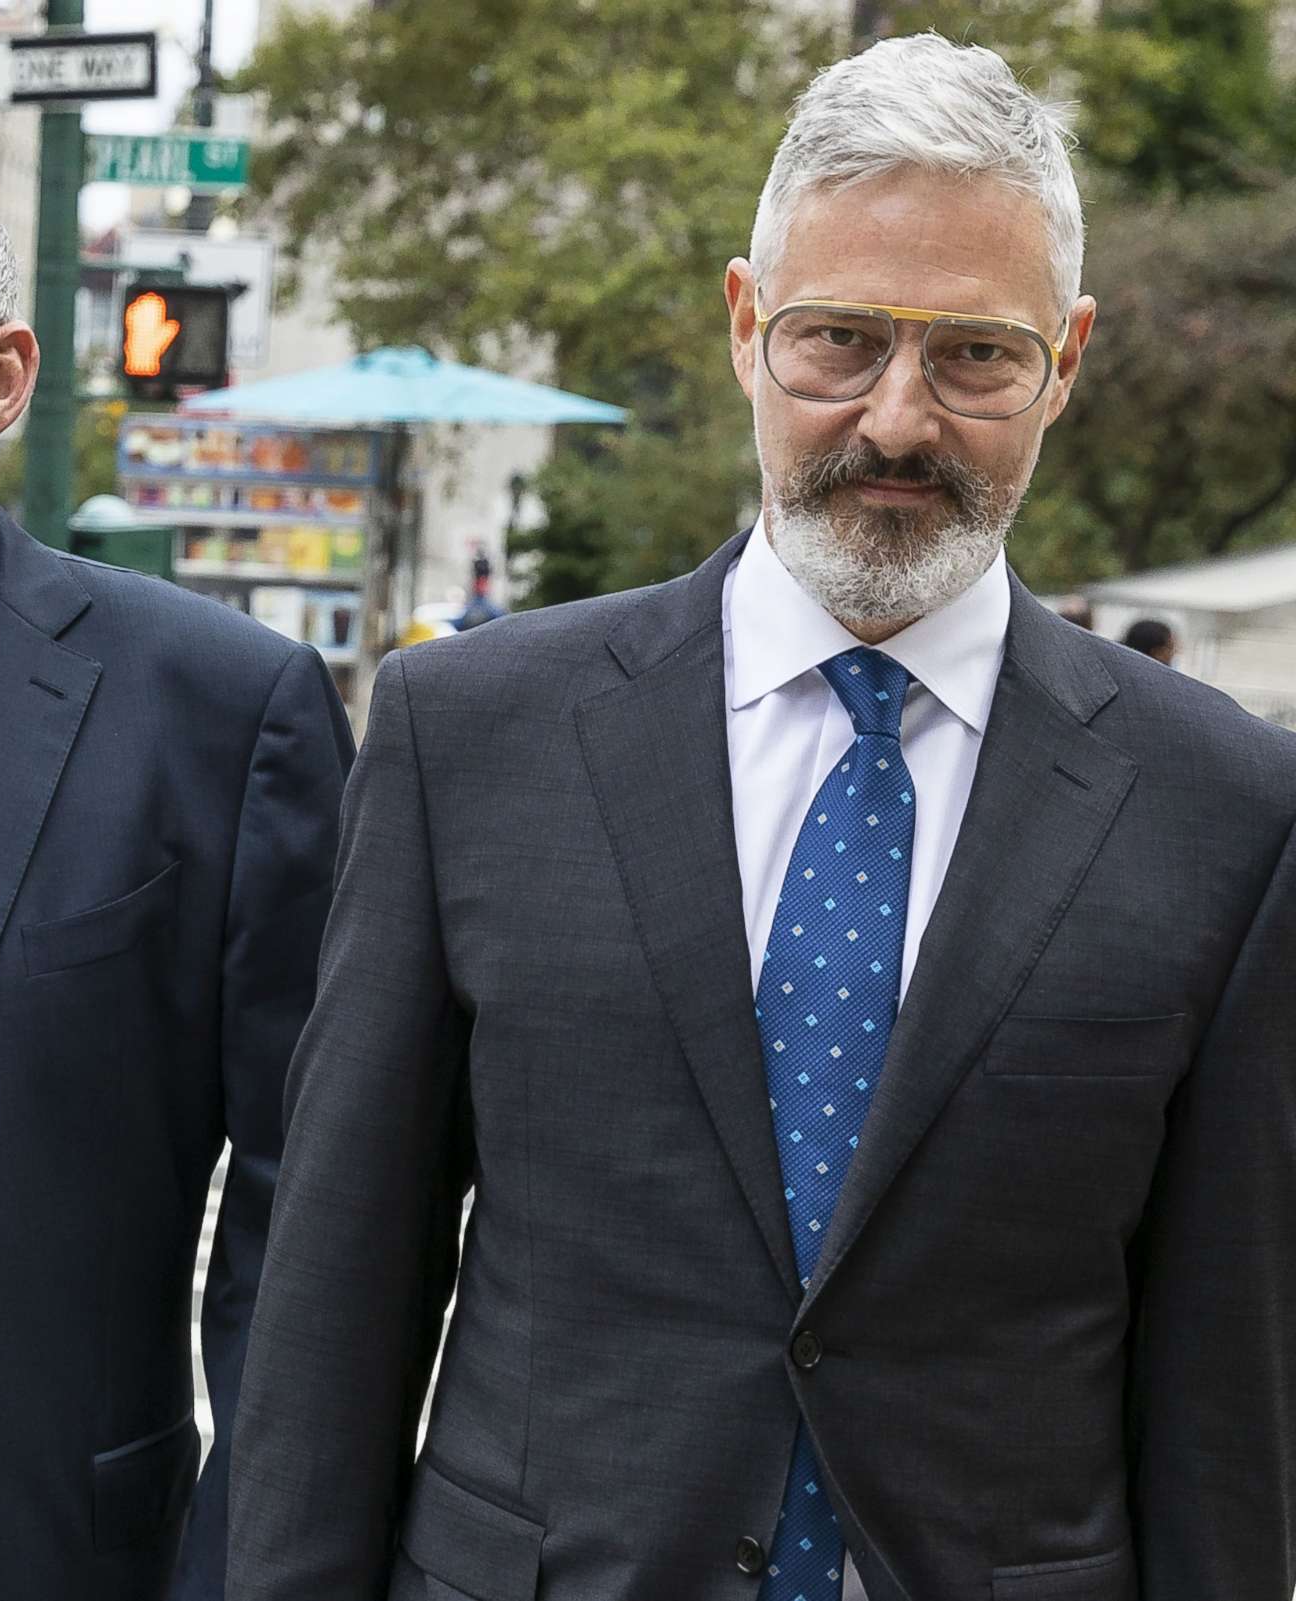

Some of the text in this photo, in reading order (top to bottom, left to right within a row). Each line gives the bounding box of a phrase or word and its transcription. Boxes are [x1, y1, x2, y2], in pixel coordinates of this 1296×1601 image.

[14, 48, 139, 86] ONE WAY
[96, 138, 240, 181] PEARL ST
